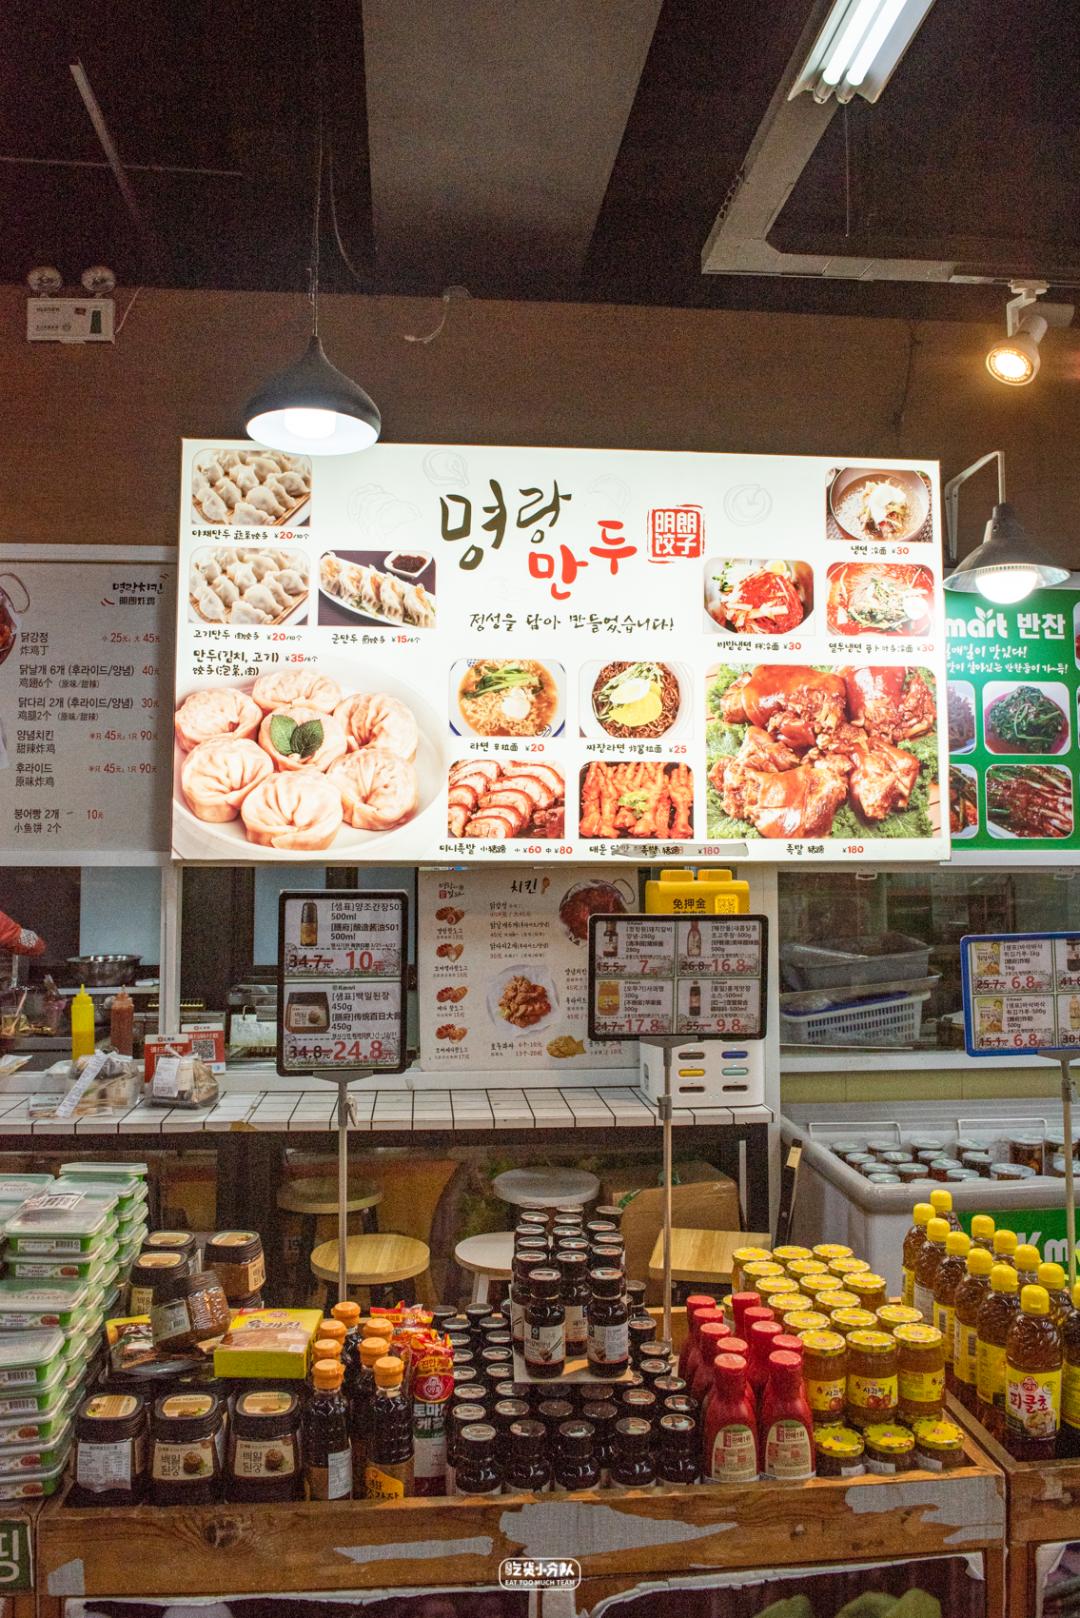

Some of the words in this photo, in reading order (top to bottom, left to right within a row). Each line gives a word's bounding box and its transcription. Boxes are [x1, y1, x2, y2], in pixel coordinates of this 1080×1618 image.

[440, 479, 572, 571] 명랑
[655, 511, 698, 533] 明朗
[655, 533, 698, 556] 饺子
[528, 520, 637, 600] 만두
[470, 613, 517, 631] 정성을
[526, 613, 561, 631] 담아
[1016, 613, 1066, 640] 반찬
[21, 632, 49, 643] 닭강정
[19, 665, 47, 675] 닭날개
[50, 665, 65, 675] 6개
[18, 697, 46, 708] 닭다리
[49, 697, 64, 708] 2개
[16, 730, 54, 741] 양념치킨
[16, 763, 53, 774] 후라이드
[14, 809, 42, 820] 붕어빵
[44, 809, 60, 820] 2개
[673, 899, 706, 909] 免押金
[331, 1003, 352, 1012] 450g
[331, 1023, 352, 1031] 450g
